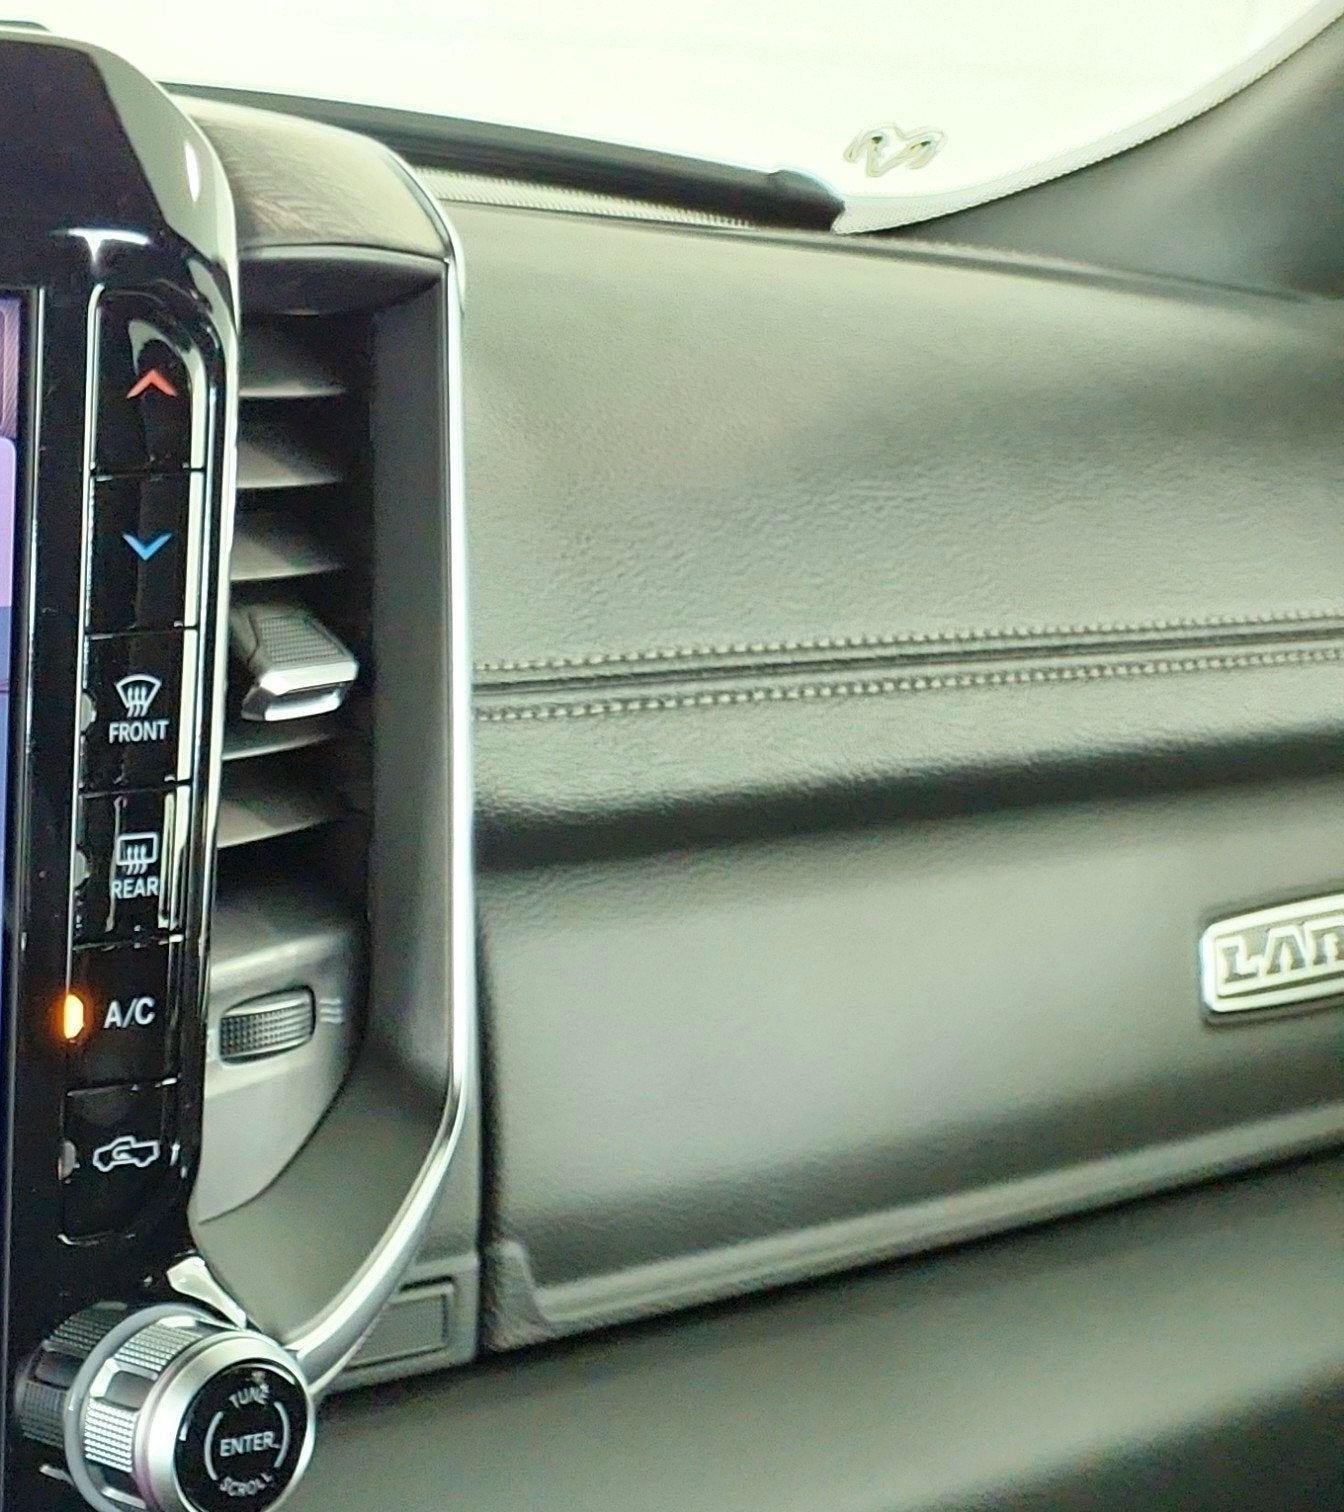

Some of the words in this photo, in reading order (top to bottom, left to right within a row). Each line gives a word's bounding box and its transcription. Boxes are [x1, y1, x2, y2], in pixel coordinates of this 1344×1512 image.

[108, 720, 169, 743] FRONT
[112, 876, 159, 899] REAR
[104, 997, 155, 1029] A/C
[220, 1430, 276, 1457] ENTER
[219, 1472, 273, 1497] SCROLL
